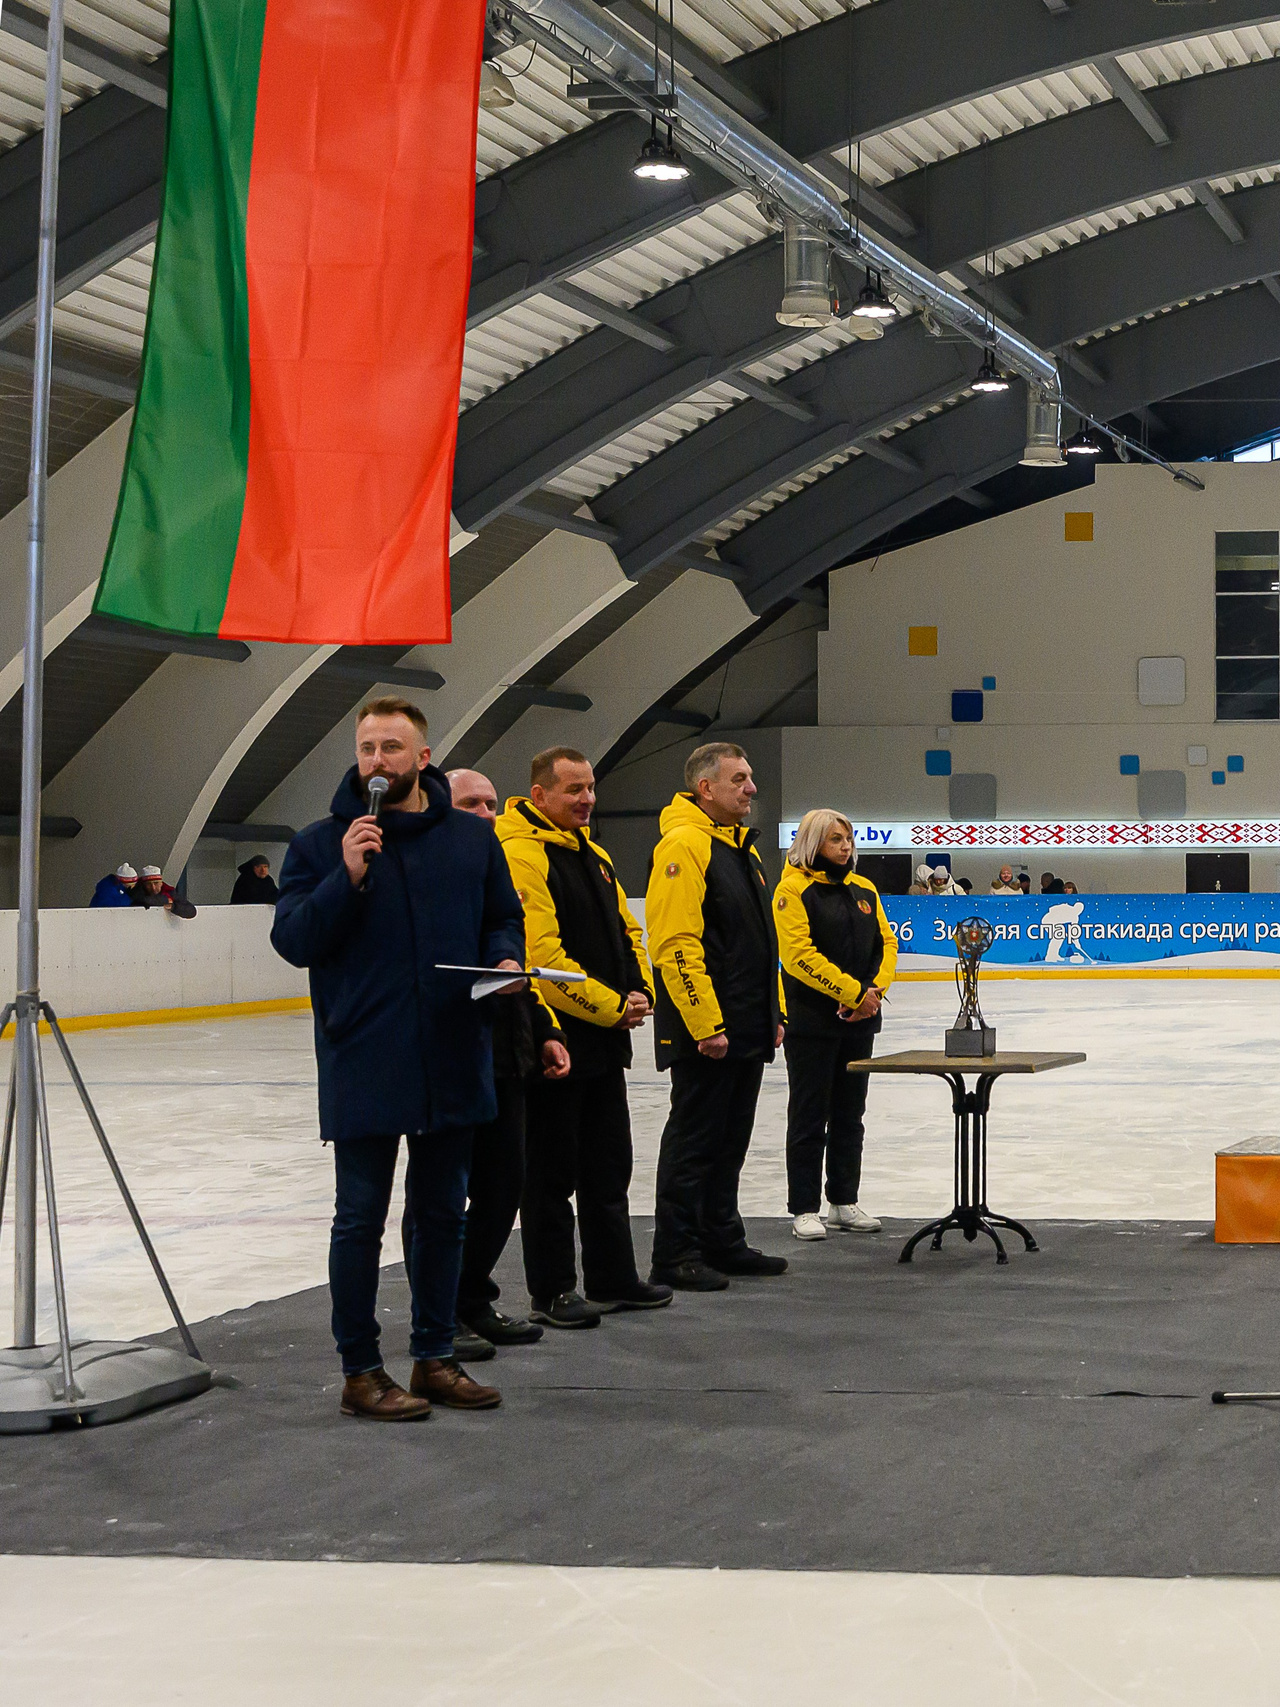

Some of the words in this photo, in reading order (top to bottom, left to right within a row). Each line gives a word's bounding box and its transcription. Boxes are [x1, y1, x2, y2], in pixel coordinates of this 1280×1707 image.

[1026, 921, 1173, 944] спартакиада
[1179, 921, 1248, 944] среди
[673, 949, 700, 1007] BELARUS
[796, 959, 843, 995] BELARUS
[551, 980, 600, 1014] ELARUS
